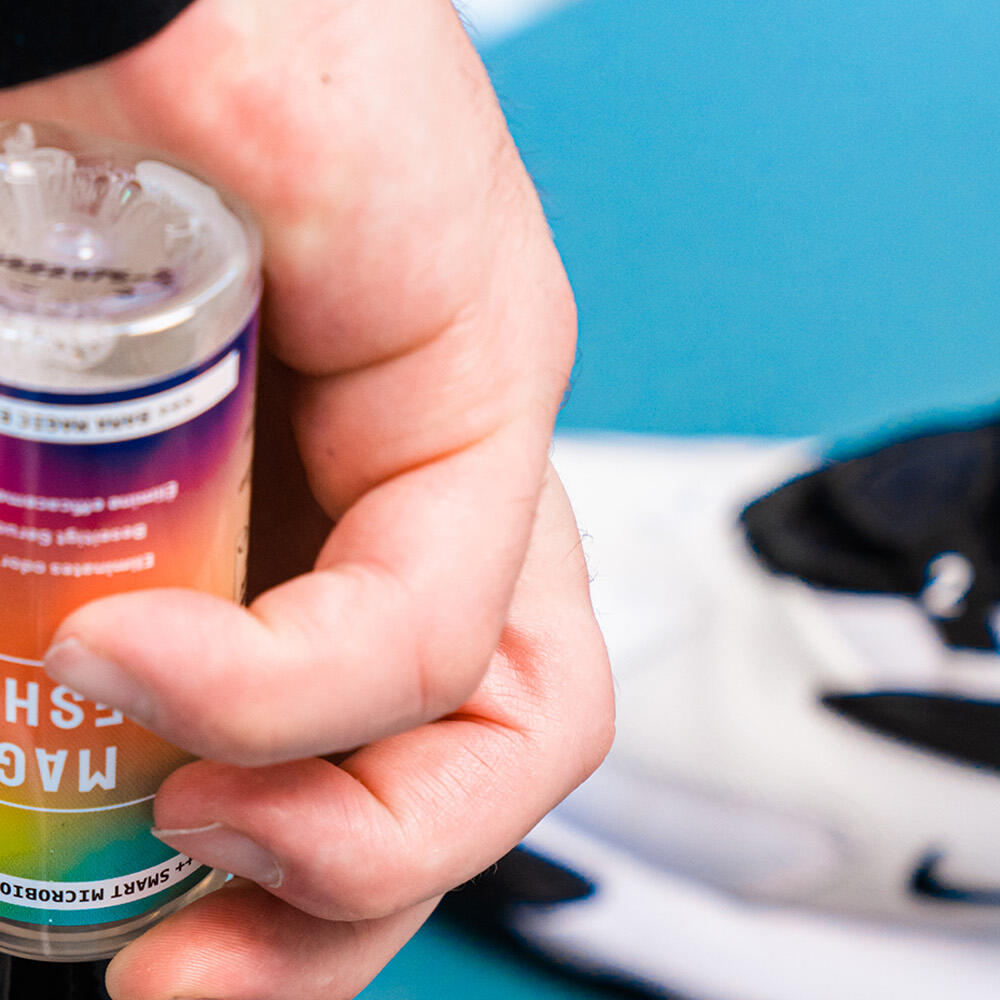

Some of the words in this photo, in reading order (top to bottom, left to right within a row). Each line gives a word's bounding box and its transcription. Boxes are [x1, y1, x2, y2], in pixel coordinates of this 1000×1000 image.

[20, 413, 89, 433] MAGIC
[1, 555, 46, 575] odor
[49, 551, 155, 576] Eliminates
[110, 867, 171, 899] SMART
